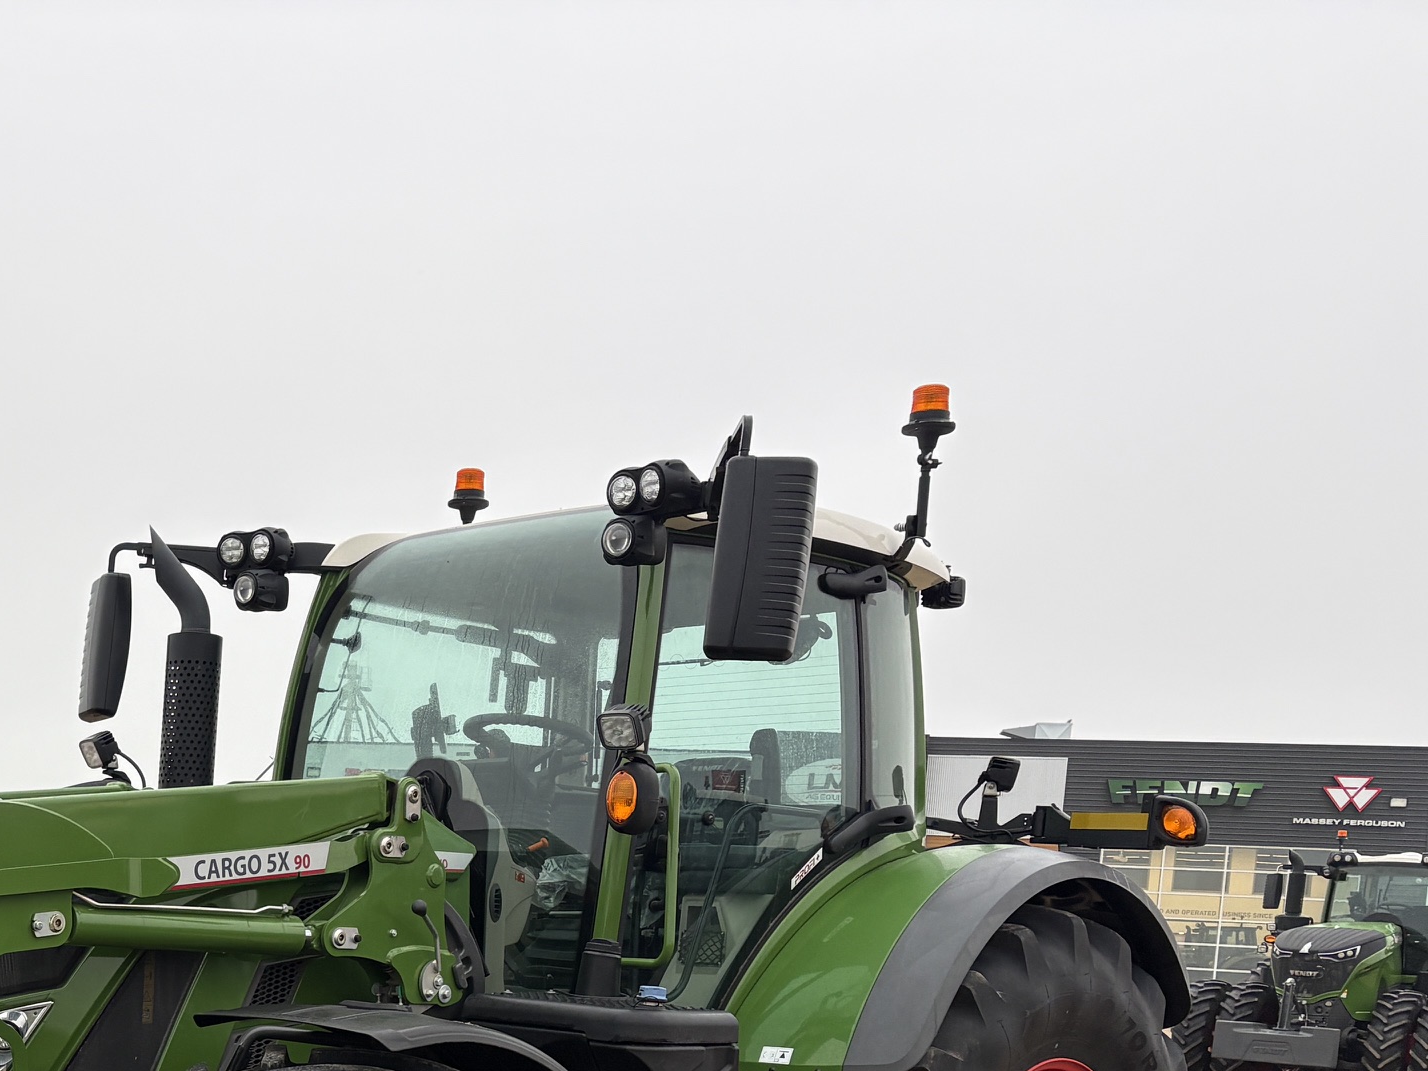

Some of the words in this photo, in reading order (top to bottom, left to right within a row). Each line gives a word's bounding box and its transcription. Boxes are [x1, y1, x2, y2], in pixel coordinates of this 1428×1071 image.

[1108, 779, 1264, 806] FENDT
[1292, 817, 1341, 825] MASSEY
[1343, 819, 1406, 827] FERGUSON
[194, 855, 262, 881] CARGO
[267, 851, 290, 873] 5X
[294, 853, 311, 870] 90
[1182, 909, 1216, 917] OPERATED
[1222, 911, 1252, 919] USINESS
